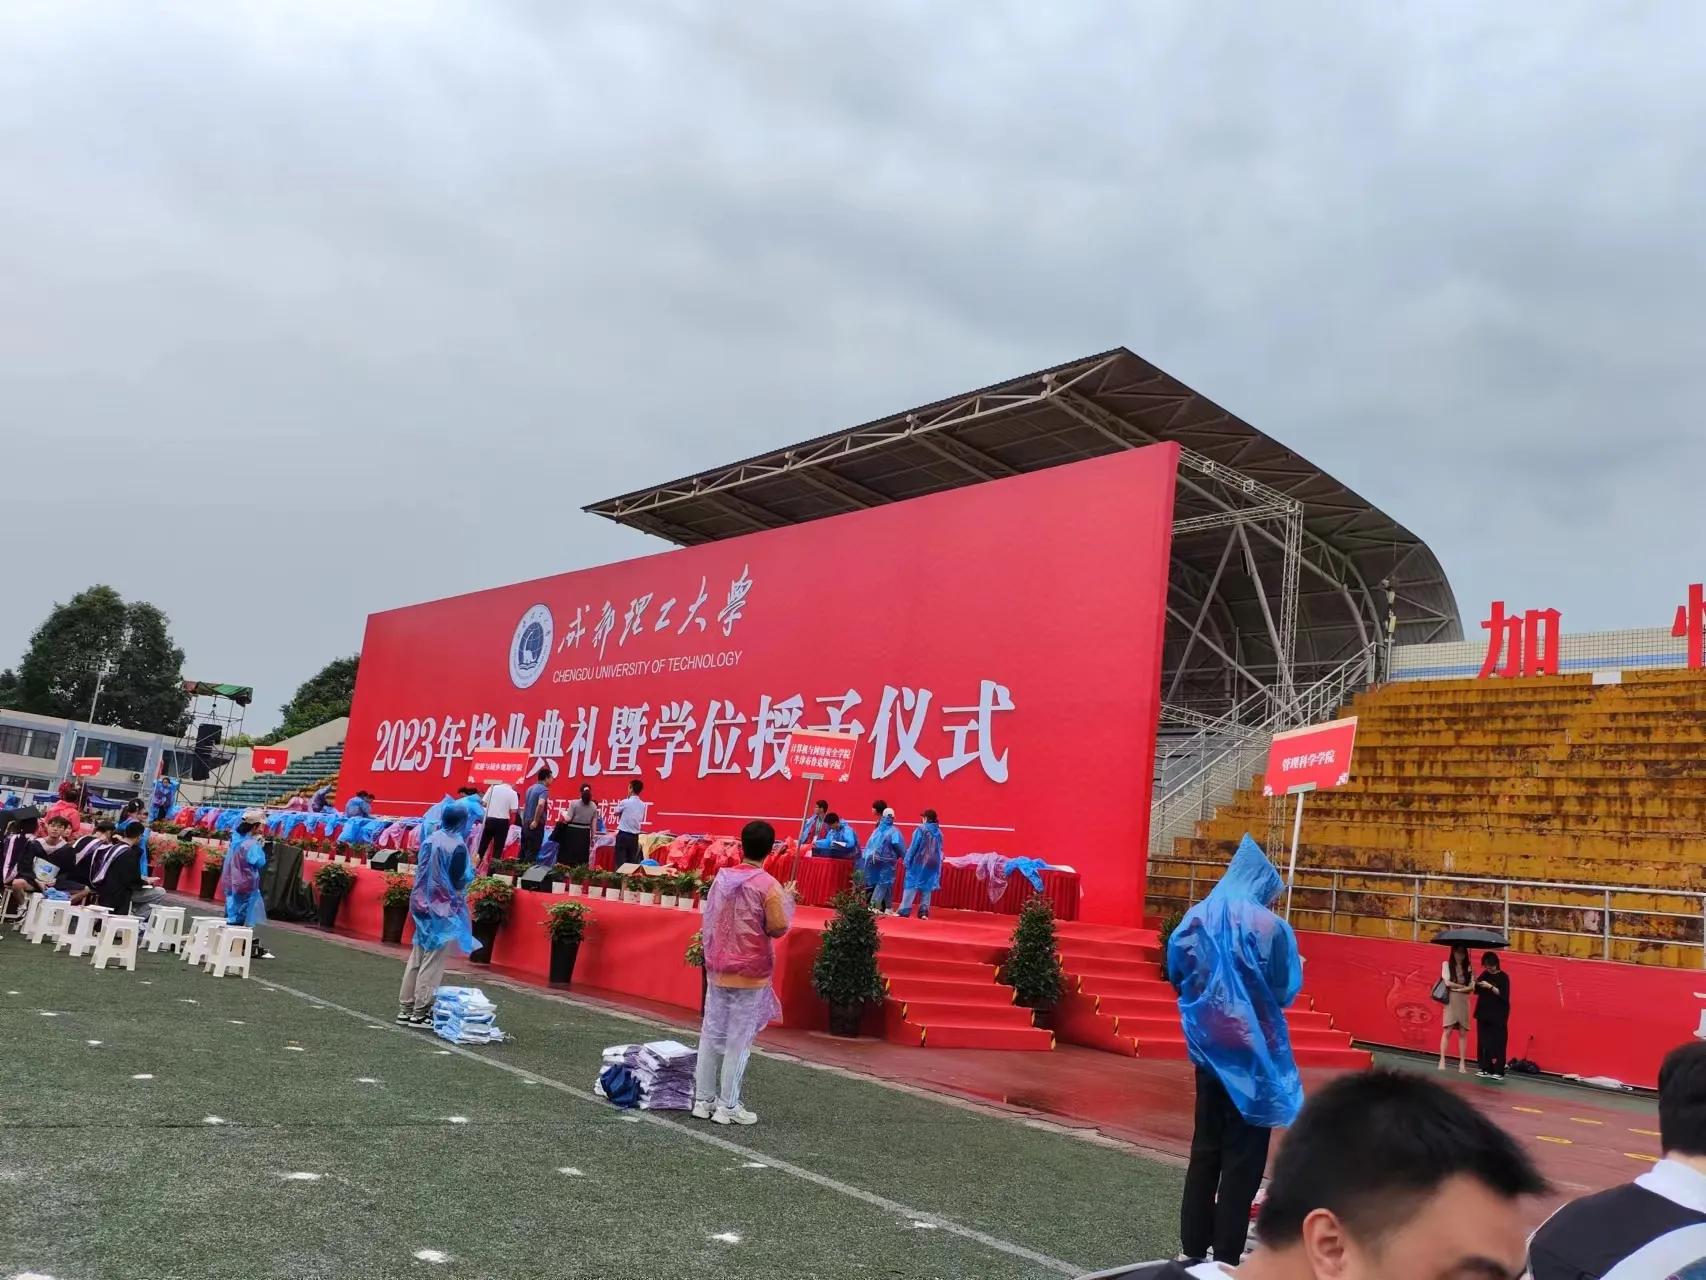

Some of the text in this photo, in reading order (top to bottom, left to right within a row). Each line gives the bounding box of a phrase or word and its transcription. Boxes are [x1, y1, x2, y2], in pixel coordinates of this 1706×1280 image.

[1477, 601, 1562, 679] 加
[552, 650, 743, 684] CHENGDU UNIVERSITY OF TECHNOLOGY
[1282, 750, 1335, 772] 管理科学学院
